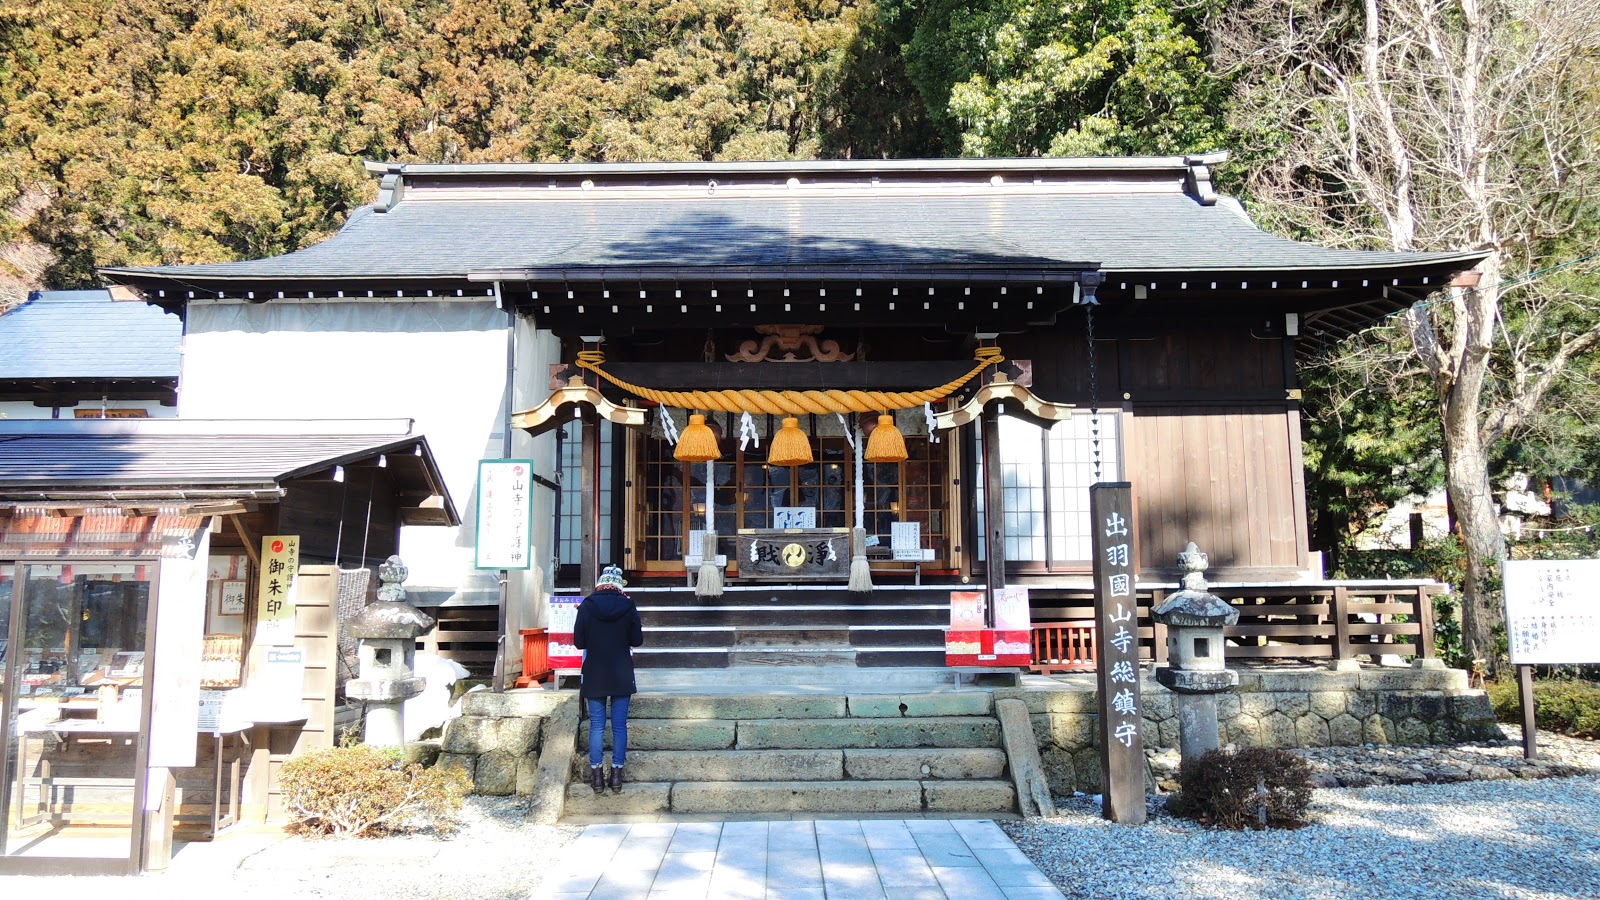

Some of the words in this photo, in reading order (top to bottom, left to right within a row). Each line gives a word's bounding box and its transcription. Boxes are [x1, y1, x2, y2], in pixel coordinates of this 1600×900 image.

[266, 557, 286, 617] 御朱印
[1105, 512, 1138, 748] 出羽國山寺総鎮守
